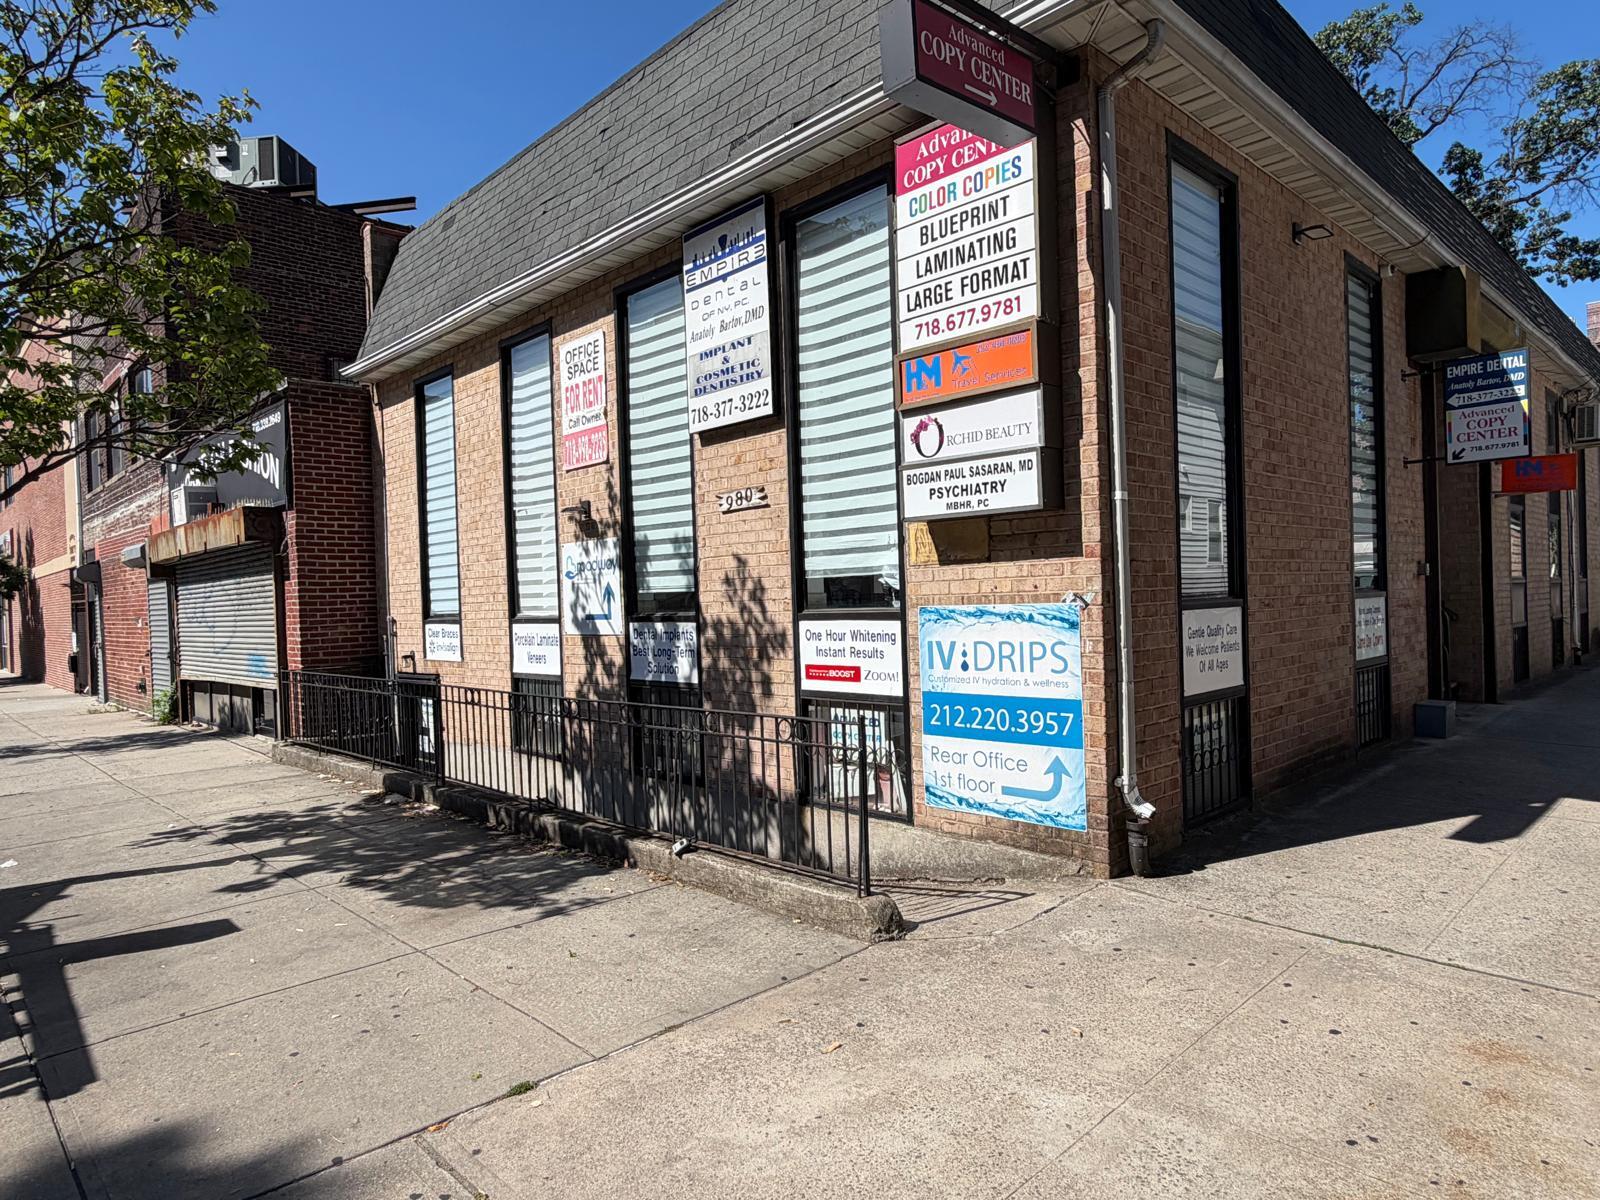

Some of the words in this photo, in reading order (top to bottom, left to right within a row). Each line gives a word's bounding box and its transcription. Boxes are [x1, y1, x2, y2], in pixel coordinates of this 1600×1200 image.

[949, 24, 1005, 66] Advanced
[920, 30, 966, 71] COPY
[970, 56, 1032, 105] CENTER
[916, 129, 974, 161] Advan
[903, 154, 948, 188] COPY
[951, 138, 1004, 168] CENT
[909, 182, 957, 218] COLOR
[962, 155, 1022, 197] COPIES
[920, 195, 1010, 247] BLUEPRINT
[916, 227, 1017, 279] LAMINATING
[906, 281, 953, 313] LARGE
[960, 257, 1030, 297] FORMAT
[702, 309, 716, 322] OF
[915, 295, 1021, 340] 718.677.9781
[689, 324, 716, 344] Anatoly
[565, 339, 600, 365] OFFICE
[699, 335, 754, 362] IMPLANT
[721, 355, 731, 365] &
[567, 356, 599, 380] SPACE
[696, 358, 760, 385] COSMETIC
[1447, 361, 1484, 378] EMPIRE
[1487, 354, 1527, 372] DENTAL
[1503, 372, 1525, 382] DMD
[694, 368, 764, 397] DENTISTRY
[565, 382, 581, 416] FOR
[582, 374, 603, 410] RENT
[691, 388, 769, 425] 718-377-3222
[568, 416, 580, 429] Call
[581, 411, 602, 425] Owner
[1459, 404, 1515, 420] Advanced
[1466, 415, 1508, 431] COPY
[985, 422, 1032, 441] BEAUTY
[1456, 426, 1518, 444] CENTER
[906, 470, 942, 485] BOGDAN
[944, 467, 966, 481] PAUL
[968, 461, 1016, 478] SASARAN,
[1019, 459, 1034, 472] MD
[725, 487, 753, 511] 980
[929, 479, 1007, 500] PSYCHIATRY
[946, 500, 975, 511] MBHR,
[977, 498, 990, 508] PC
[633, 630, 658, 640] Dental
[660, 628, 694, 642] Implants
[805, 629, 823, 642] One
[825, 629, 847, 643] Hour
[849, 629, 896, 645] Whitening
[1226, 623, 1238, 635] Care
[632, 645, 650, 656] Best
[653, 645, 695, 660] Long-Term
[815, 645, 846, 658] Instant
[849, 646, 885, 660] Results
[927, 640, 957, 670] IV
[973, 640, 1069, 674] DRIPS
[647, 662, 679, 675] Solution
[828, 669, 855, 679] BOOST
[1216, 658, 1228, 672] Ages
[928, 674, 971, 684] Customized
[972, 676, 981, 685] IV
[981, 676, 1022, 688] hydration
[1024, 678, 1030, 687] &
[1032, 678, 1069, 689] wellness
[930, 703, 1074, 736] 212.220.3957
[931, 746, 969, 766] Rear
[973, 750, 1028, 773] Office
[933, 770, 952, 788] 1st
[957, 772, 995, 794] floor
